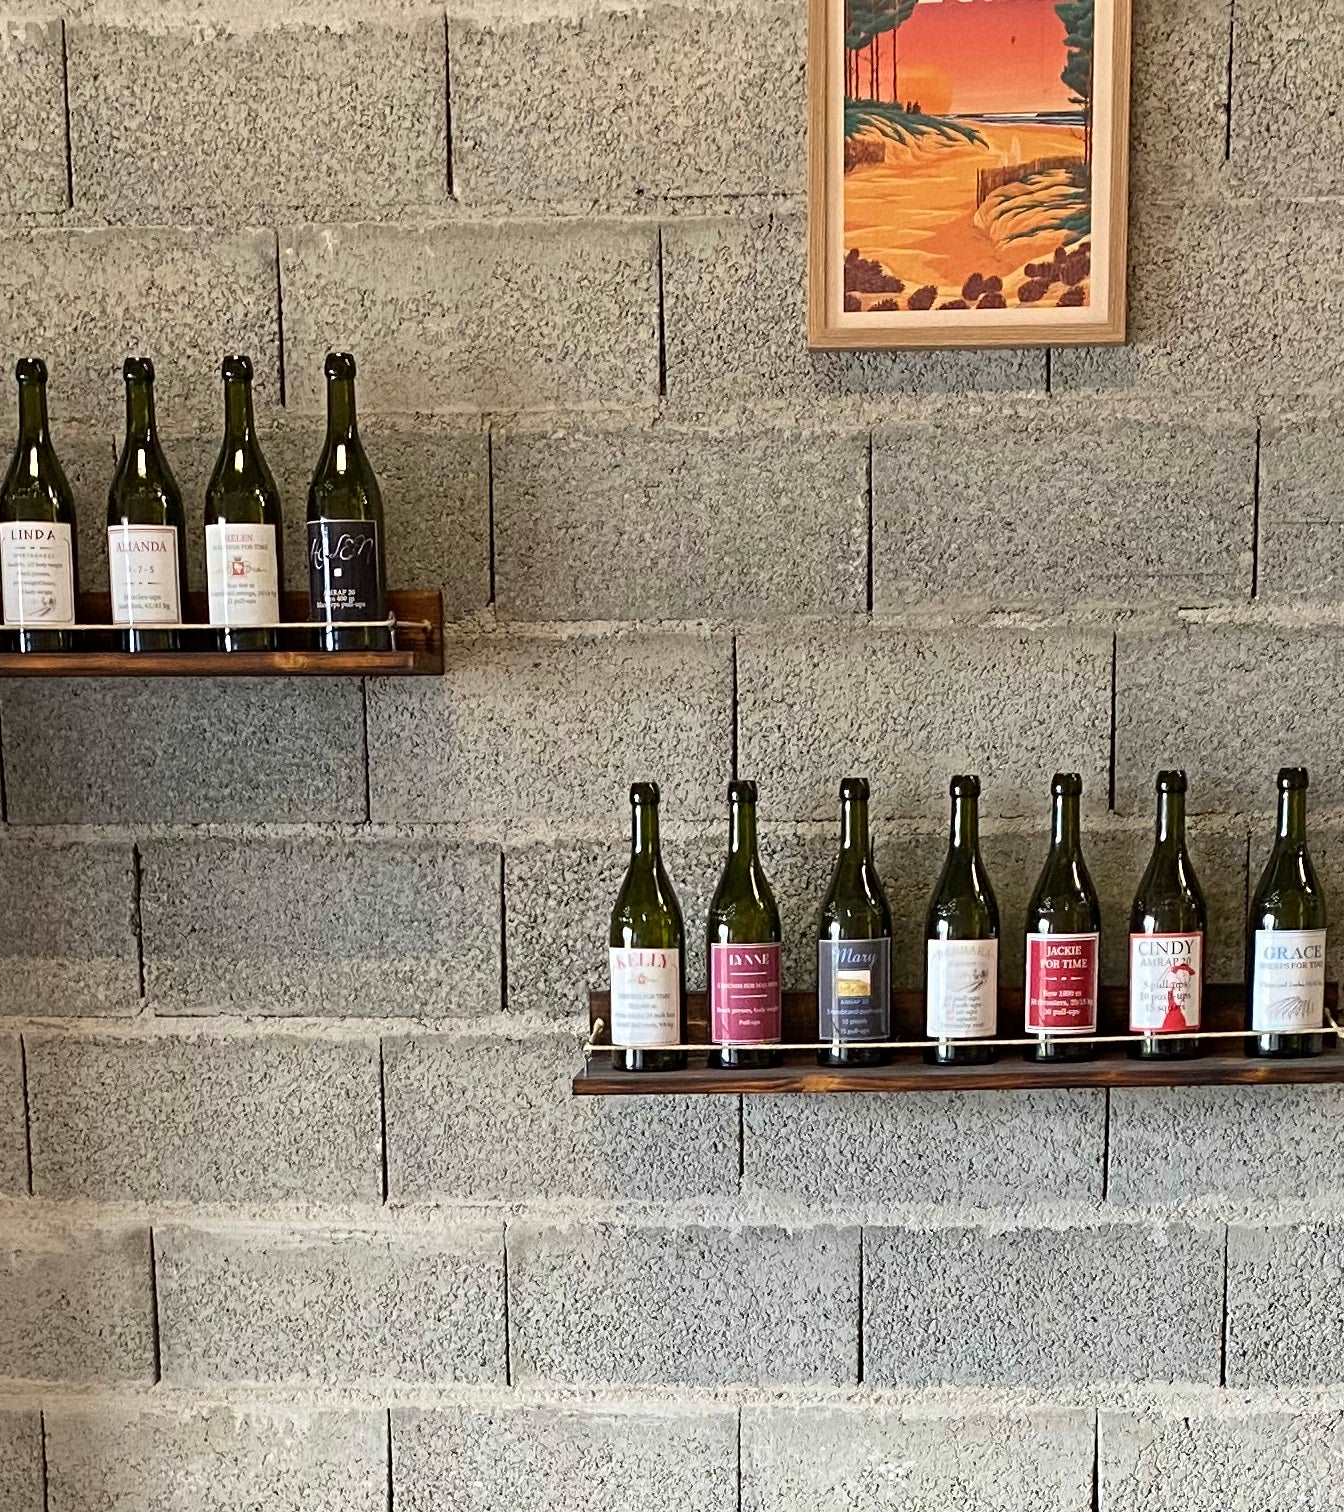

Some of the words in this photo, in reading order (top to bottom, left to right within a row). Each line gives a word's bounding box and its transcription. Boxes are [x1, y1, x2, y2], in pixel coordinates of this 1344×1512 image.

[11, 529, 56, 541] LINDA
[117, 541, 167, 553] AANDA
[1046, 945, 1082, 956] JACKIE
[1138, 940, 1195, 956] CINDY
[1263, 945, 1322, 959] GRACE
[616, 953, 667, 968] KELLY
[729, 953, 770, 966] LYNNE
[835, 948, 878, 968] Mary
[1040, 959, 1060, 969] FOR
[1062, 959, 1088, 969] TIME
